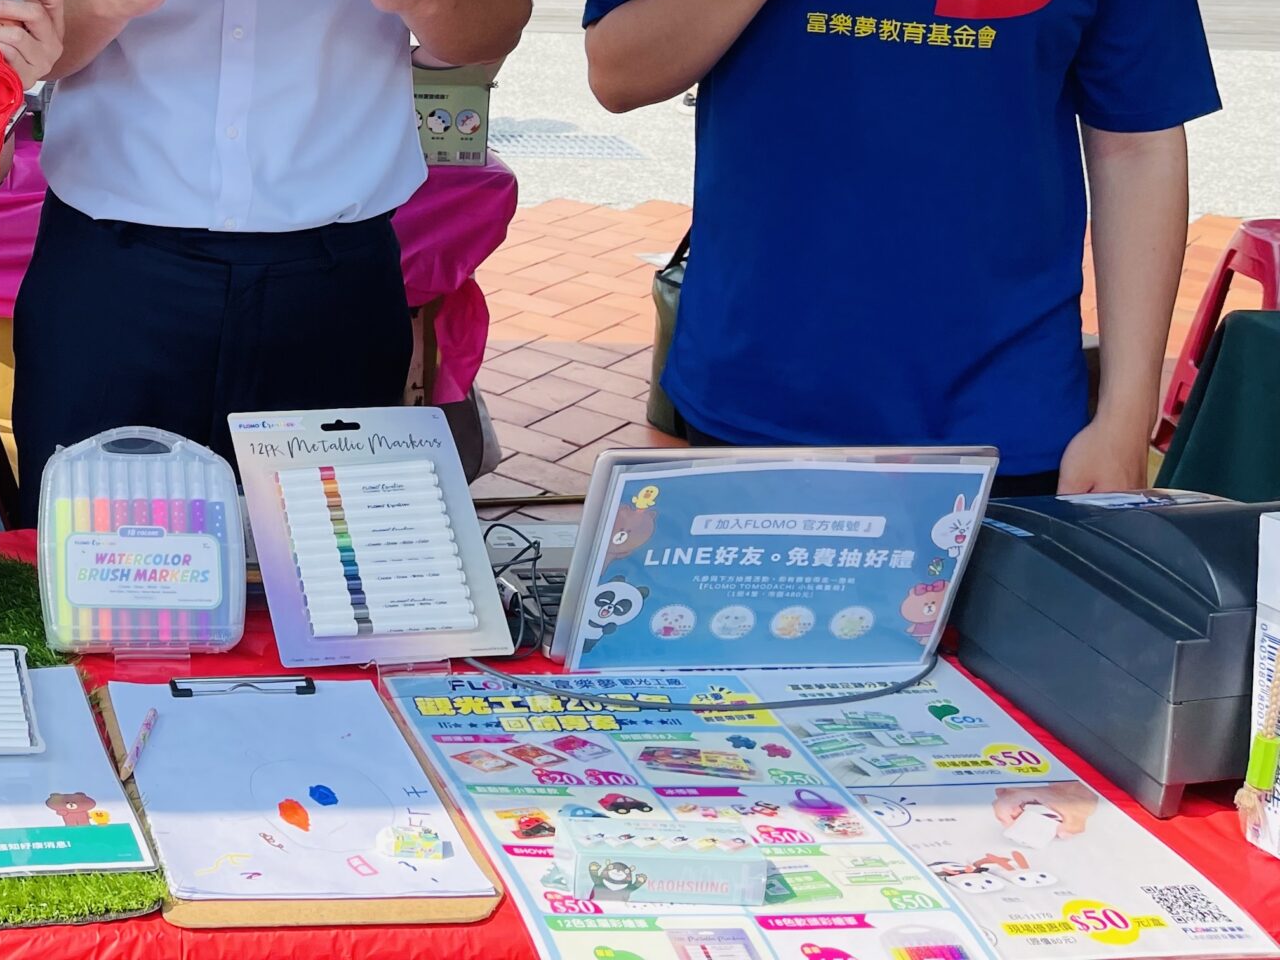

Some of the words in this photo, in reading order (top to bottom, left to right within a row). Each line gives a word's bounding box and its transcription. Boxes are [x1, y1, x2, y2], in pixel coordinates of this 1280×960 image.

[806, 11, 997, 49] 富樂夢教育基金會
[368, 433, 442, 455] Markers
[95, 552, 193, 567] WATERCOLOR
[78, 568, 132, 582] BRUSH
[133, 568, 211, 583] MARKERS
[550, 678, 618, 690] 富樂夢
[988, 750, 1042, 767] $50
[541, 773, 578, 786] $20
[587, 773, 636, 786] $100
[763, 830, 815, 844] $500
[647, 879, 730, 894] KAOHSIUNG
[555, 900, 596, 914] $50
[891, 893, 934, 910] $50
[1006, 921, 1074, 935] 現場優惠價
[1070, 908, 1129, 933] $50
